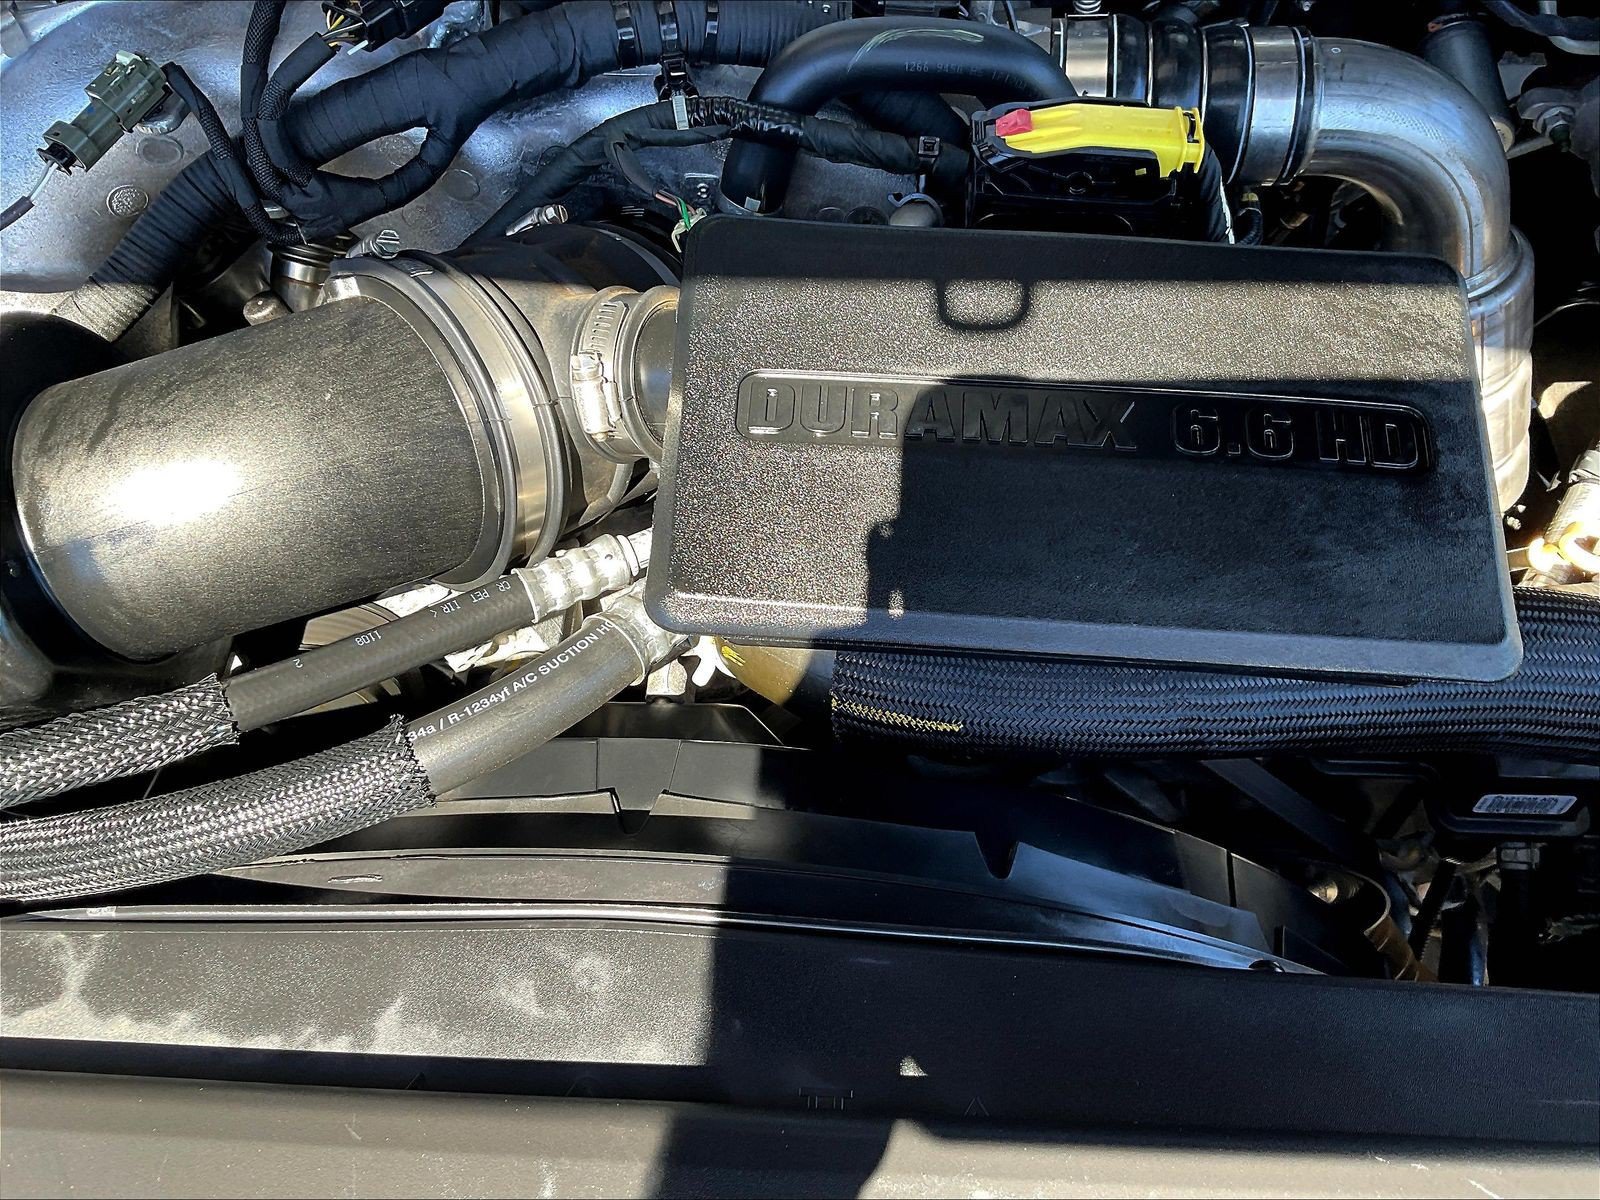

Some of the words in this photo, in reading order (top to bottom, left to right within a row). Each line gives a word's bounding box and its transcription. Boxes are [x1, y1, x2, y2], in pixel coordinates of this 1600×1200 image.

[749, 382, 1138, 450] DURAMAX
[1172, 403, 1295, 459] 6.6
[1315, 409, 1419, 470] HD
[498, 580, 512, 592] CR
[470, 588, 491, 603] PET
[354, 629, 382, 647] 1108
[293, 657, 303, 669] 2
[447, 687, 511, 725] R-1234yf
[513, 673, 538, 694] A/C
[538, 633, 599, 676] SUCTION
